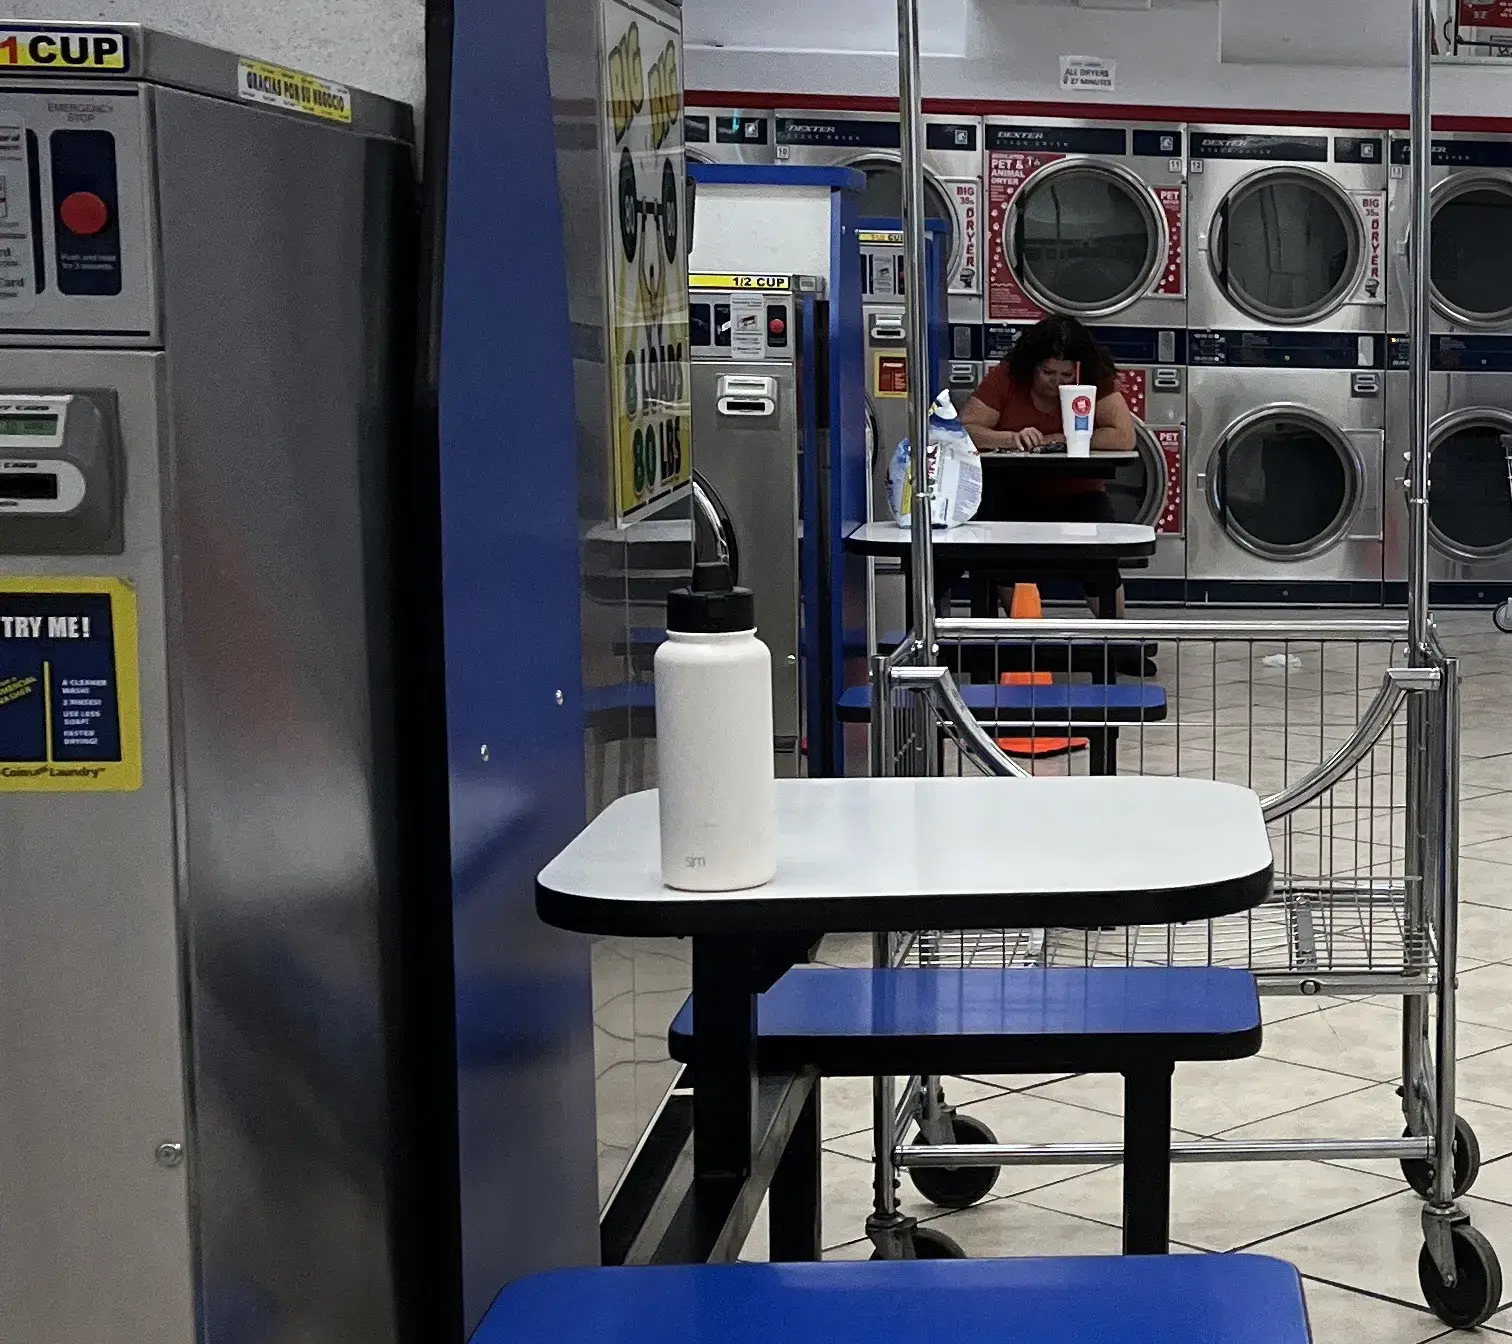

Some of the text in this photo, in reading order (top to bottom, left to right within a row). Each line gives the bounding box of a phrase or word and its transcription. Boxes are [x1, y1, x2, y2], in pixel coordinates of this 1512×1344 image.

[28, 35, 118, 65] CUP
[246, 71, 282, 97] GRACIAS
[284, 81, 301, 103] POR
[608, 21, 679, 150] BIG BIG
[47, 103, 113, 113] EMERGENCY
[788, 125, 836, 133] DEXTER
[998, 131, 1044, 139] DEXTER
[1201, 139, 1248, 147] DEXTER
[991, 159, 1024, 169] PET &
[991, 169, 1026, 179] ANIMAL
[991, 177, 1019, 186] DRYER
[956, 186, 975, 195] BIG
[1160, 191, 1179, 200] PET
[1362, 199, 1379, 207] BIG
[966, 207, 975, 267] DRYER
[1371, 218, 1379, 277] DRYER
[733, 277, 785, 287] 1/2 CUP
[625, 349, 638, 424] 8
[1159, 432, 1179, 441] PET
[632, 418, 681, 498] 80 LBS
[1, 616, 90, 639] TRY ME!
